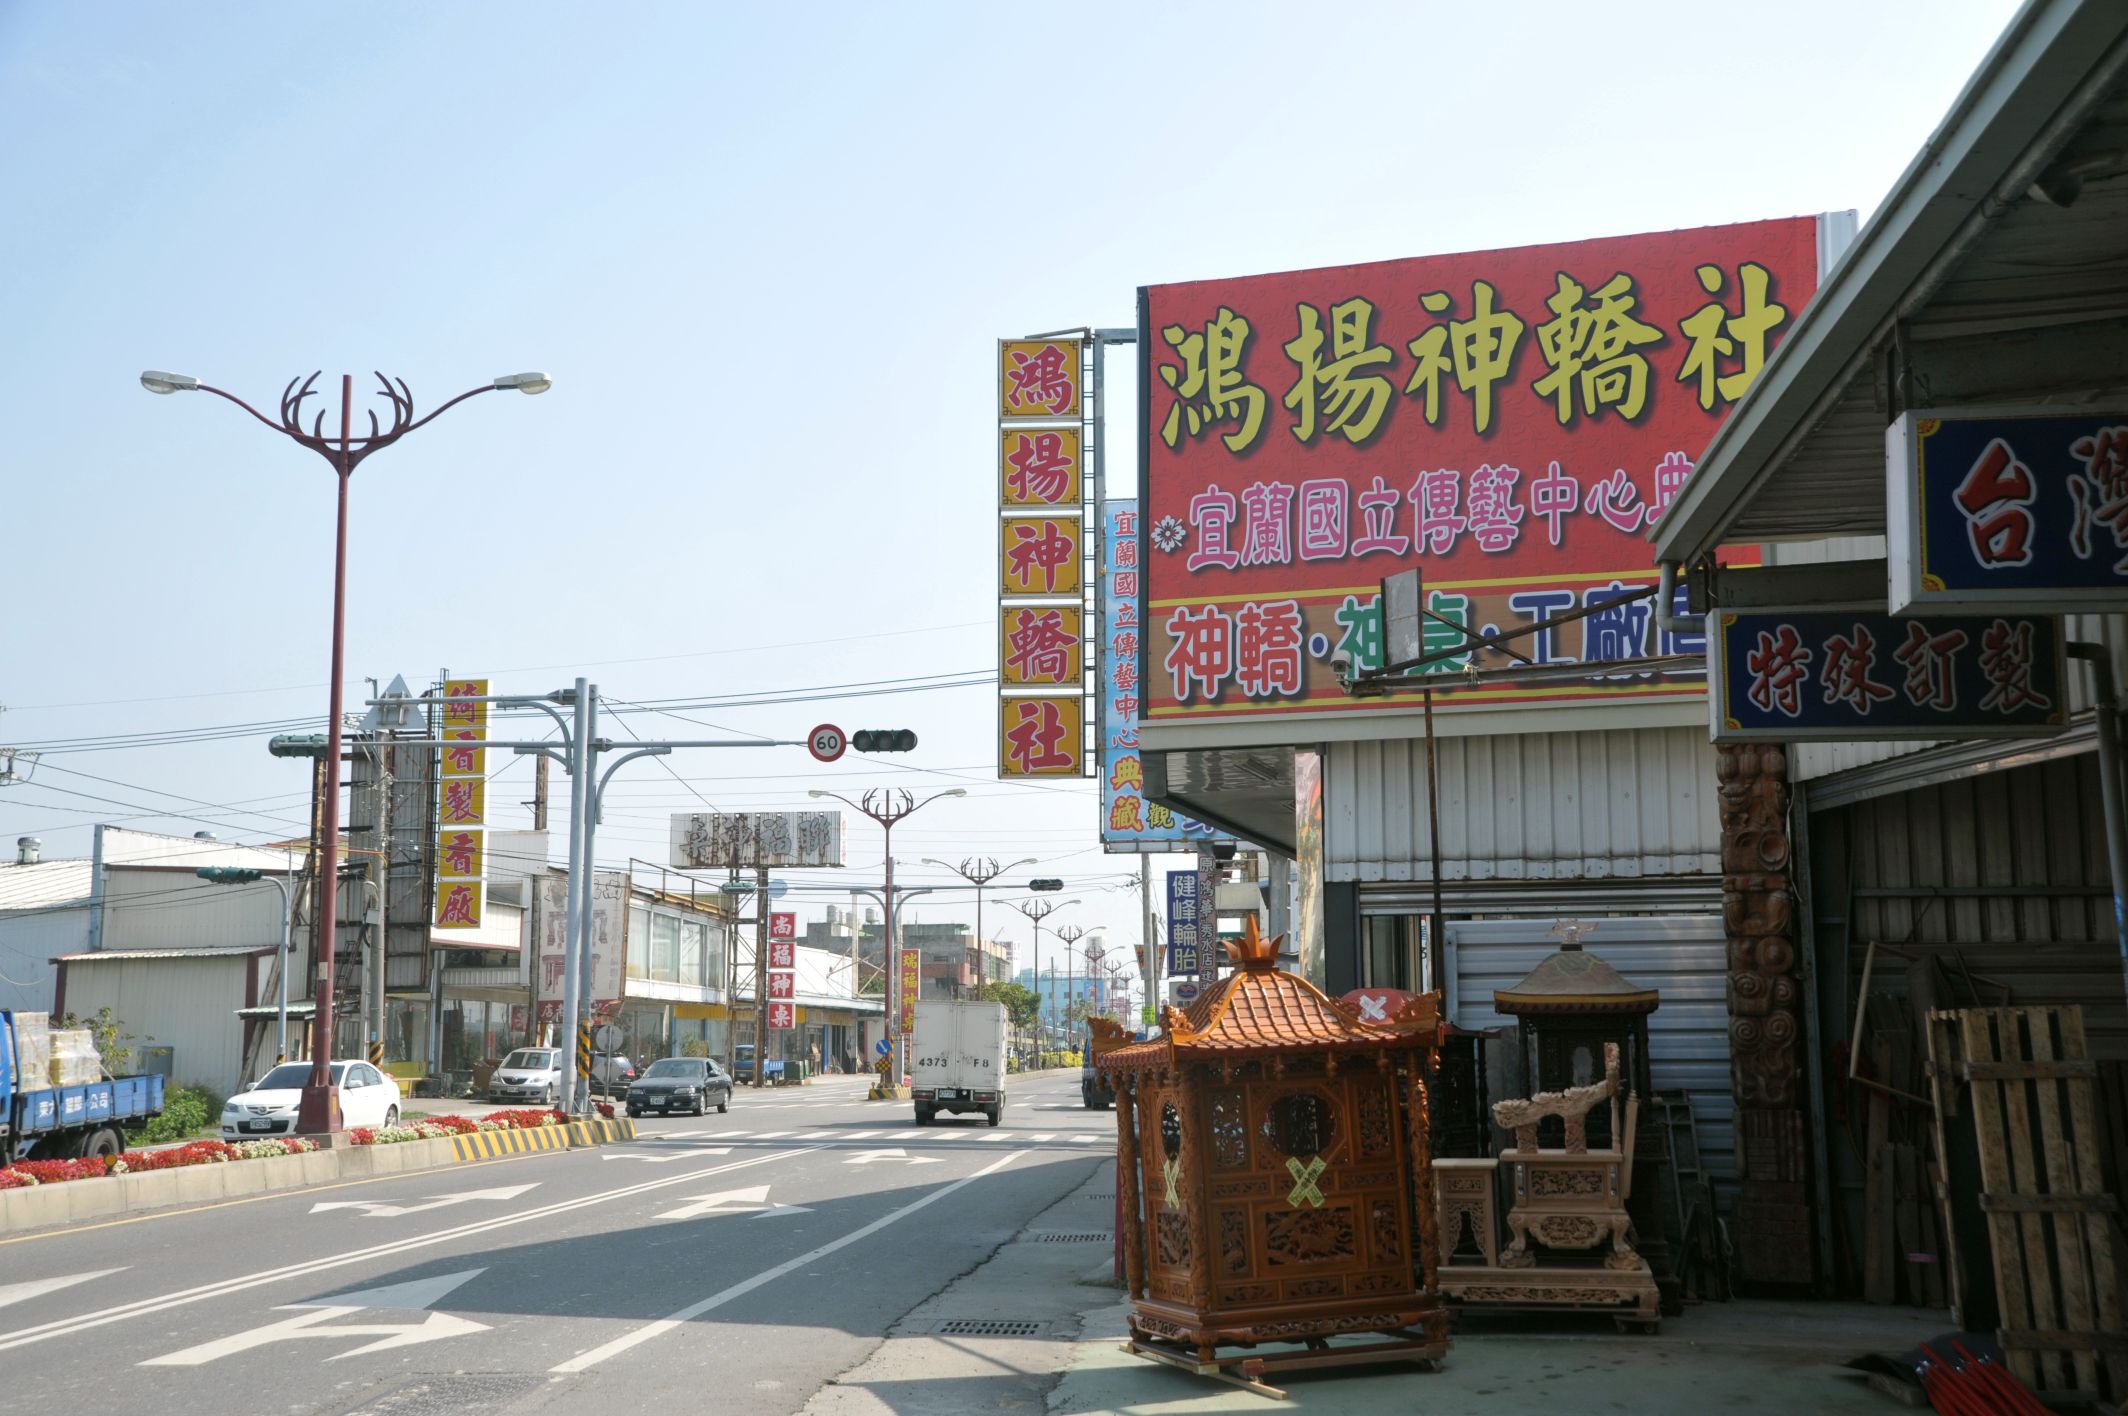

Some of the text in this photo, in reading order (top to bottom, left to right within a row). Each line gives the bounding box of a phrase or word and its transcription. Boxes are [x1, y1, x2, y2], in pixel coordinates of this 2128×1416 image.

[1158, 262, 1790, 453] 鴻揚神轎社
[1006, 345, 1080, 775] 鴻揚神轎社
[1746, 618, 2051, 718] 特殊訂製
[816, 735, 838, 750] 60
[771, 915, 792, 1028] 尚福神桌
[1172, 874, 1198, 972] 健峰輪胎
[918, 1058, 948, 1068] 4373
